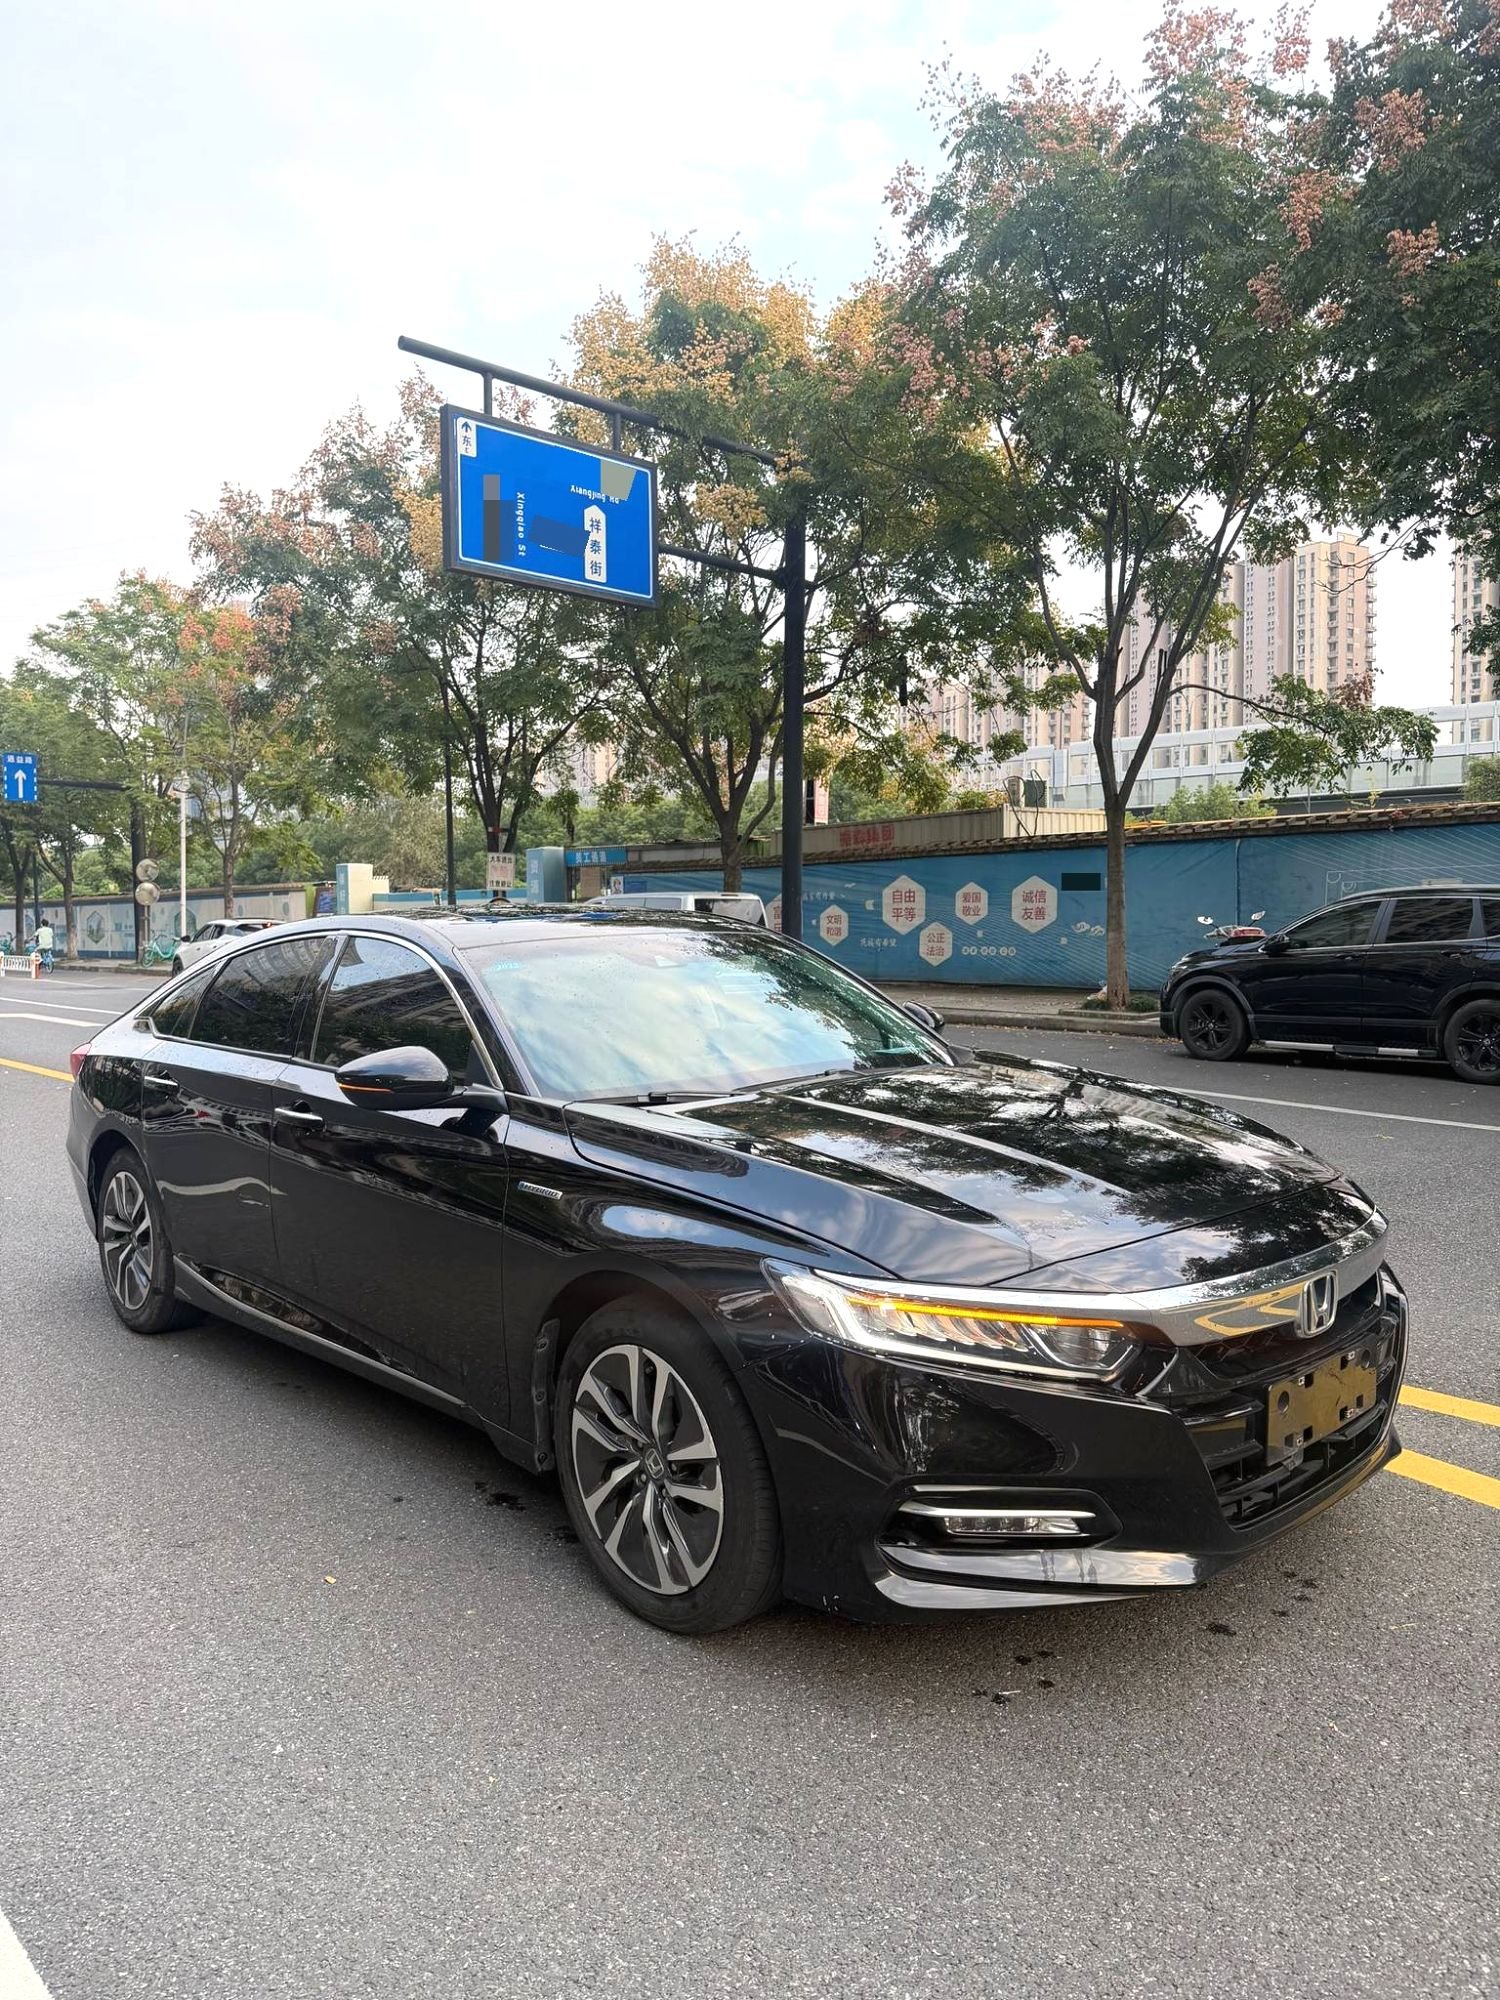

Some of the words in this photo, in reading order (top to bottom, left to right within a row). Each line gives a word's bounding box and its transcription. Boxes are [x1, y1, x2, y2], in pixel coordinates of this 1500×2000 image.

[515, 491, 526, 539] Xingqiao
[517, 543, 527, 557] St
[588, 516, 603, 577] 祥泰街
[891, 890, 917, 905] 自由
[962, 891, 982, 904] 爱国
[1022, 890, 1047, 905] 诚信
[891, 906, 917, 922] 平等
[961, 905, 981, 918] 敬业
[1021, 906, 1047, 922] 友善
[826, 914, 842, 926] 文明
[826, 926, 842, 938] 和谐
[926, 932, 945, 944] 公正
[926, 945, 945, 958] 法治
